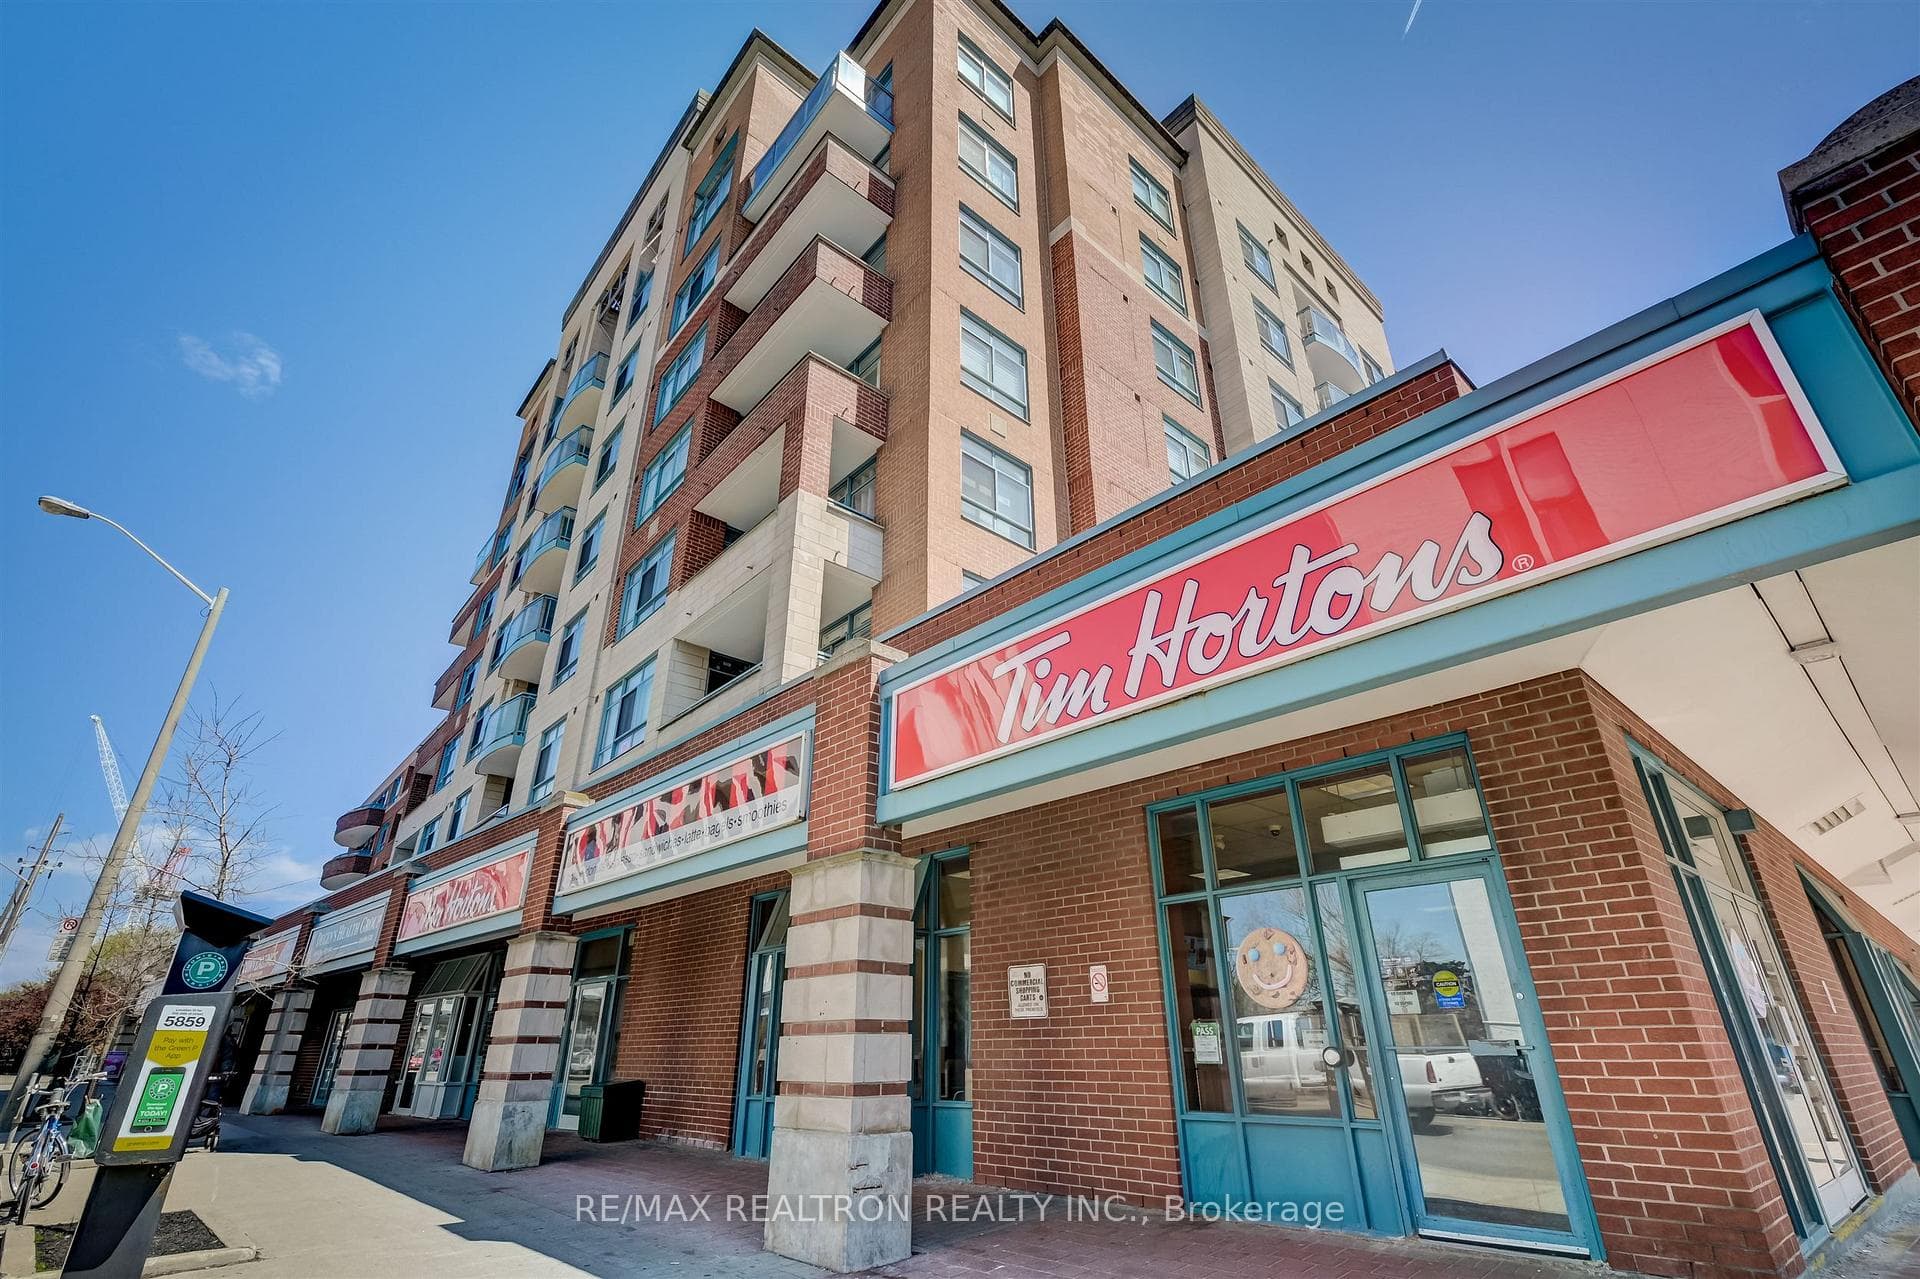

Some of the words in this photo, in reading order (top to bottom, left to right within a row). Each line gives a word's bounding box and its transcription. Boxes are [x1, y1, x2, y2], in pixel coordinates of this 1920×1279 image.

[992, 631, 1113, 744] Tim
[1123, 510, 1504, 699] Hortons
[1010, 978, 1043, 987] COMMERCIAL
[1016, 986, 1040, 994] SHOPPING
[163, 1016, 206, 1027] 5859
[1196, 1026, 1214, 1036] PASS
